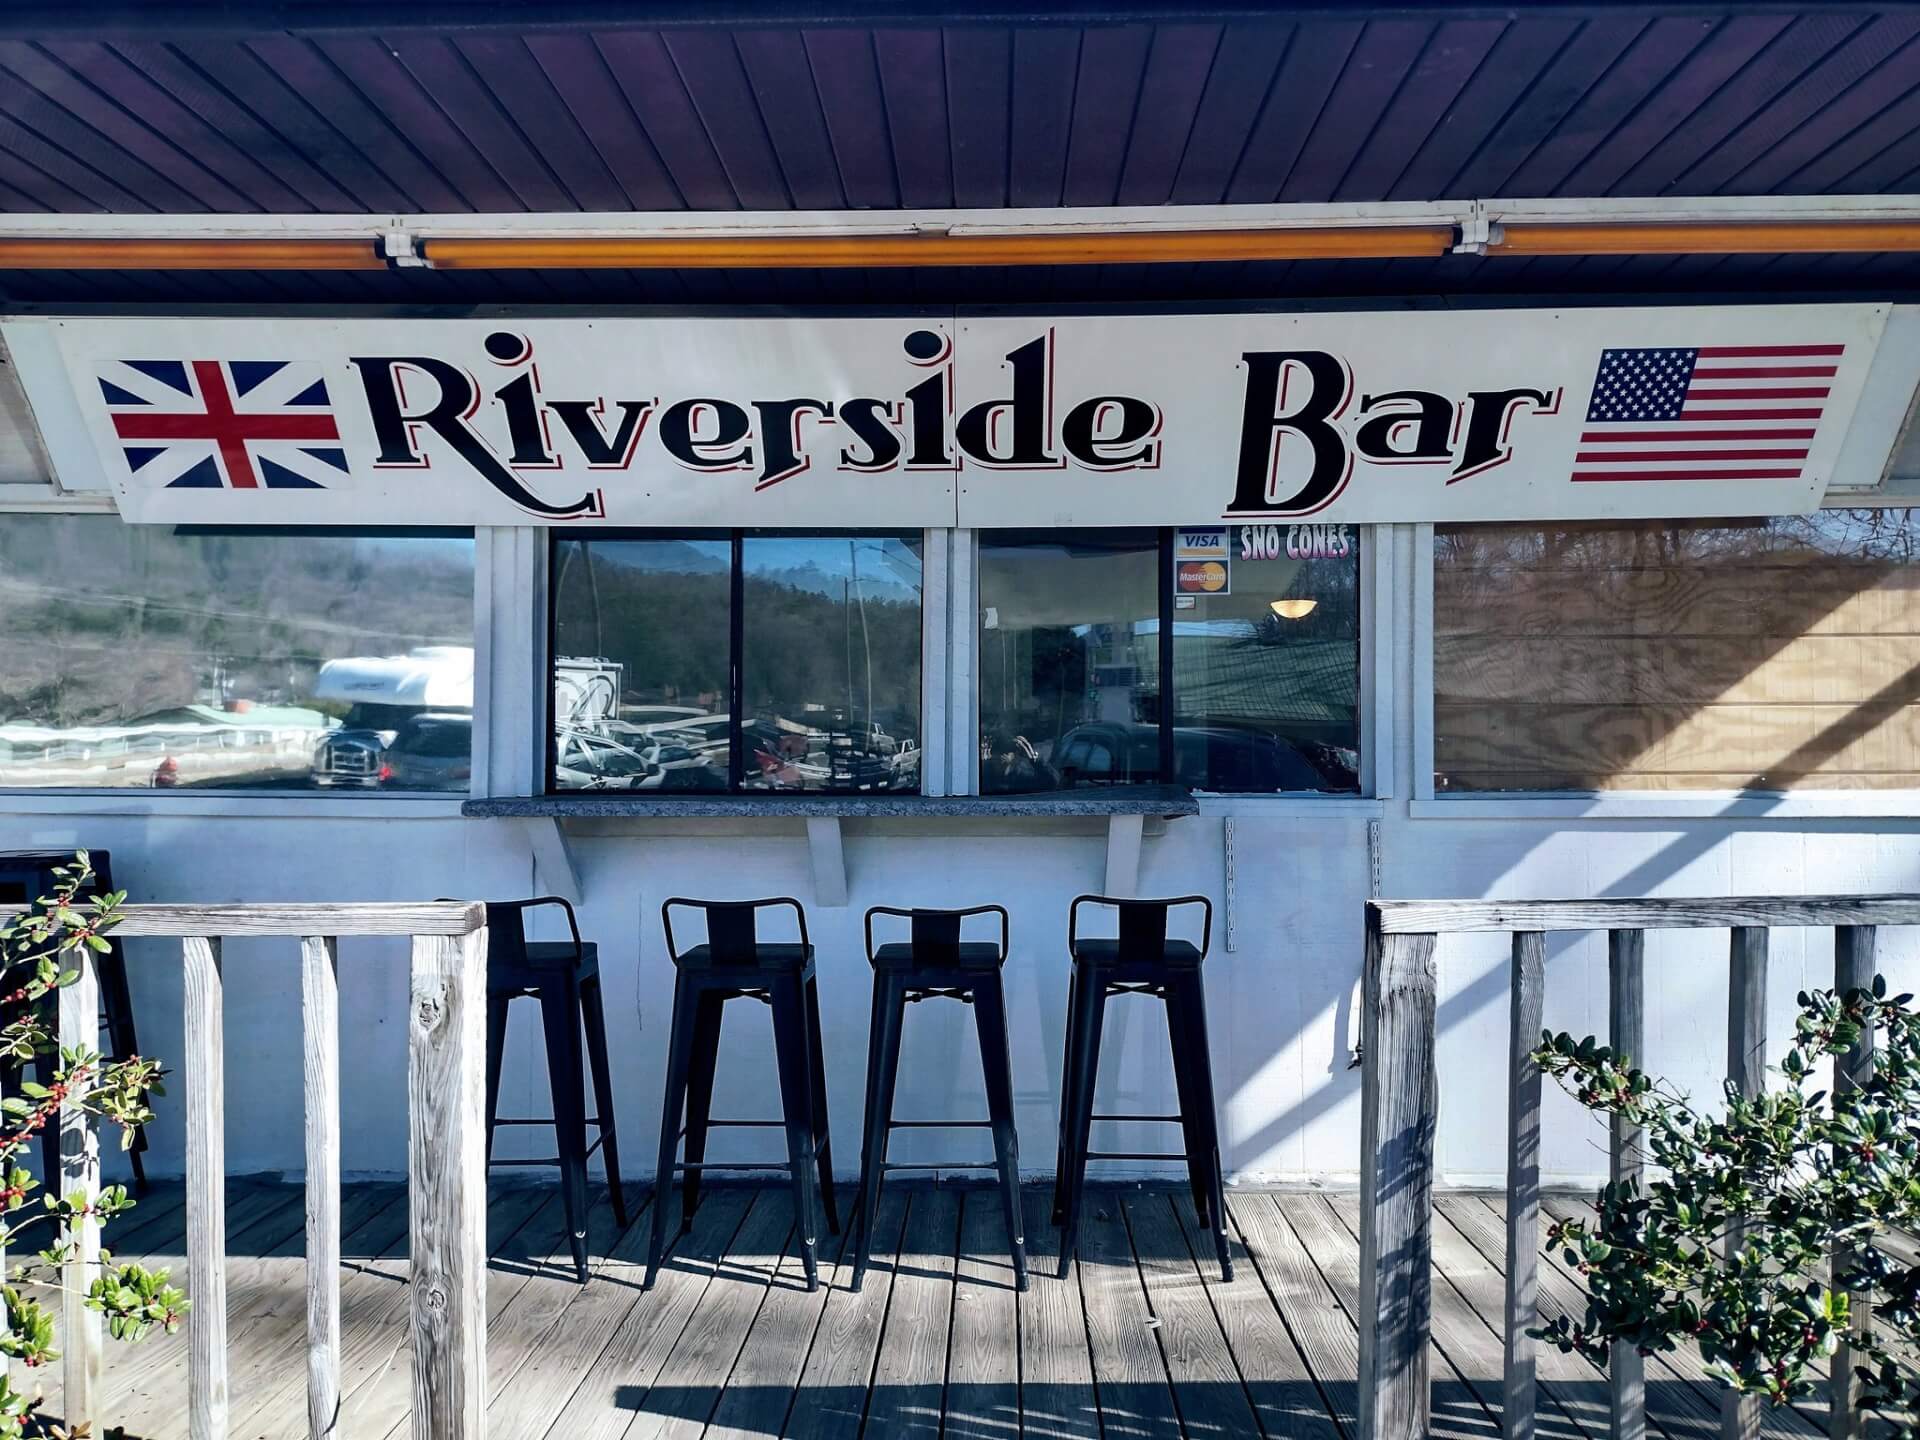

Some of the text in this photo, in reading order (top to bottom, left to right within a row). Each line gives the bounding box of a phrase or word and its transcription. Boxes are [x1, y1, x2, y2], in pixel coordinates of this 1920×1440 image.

[350, 326, 1563, 520] Riverside Bar
[1185, 535, 1220, 547] VISA
[1240, 524, 1350, 561] SNO CONES
[1179, 572, 1225, 583] MasterCard
